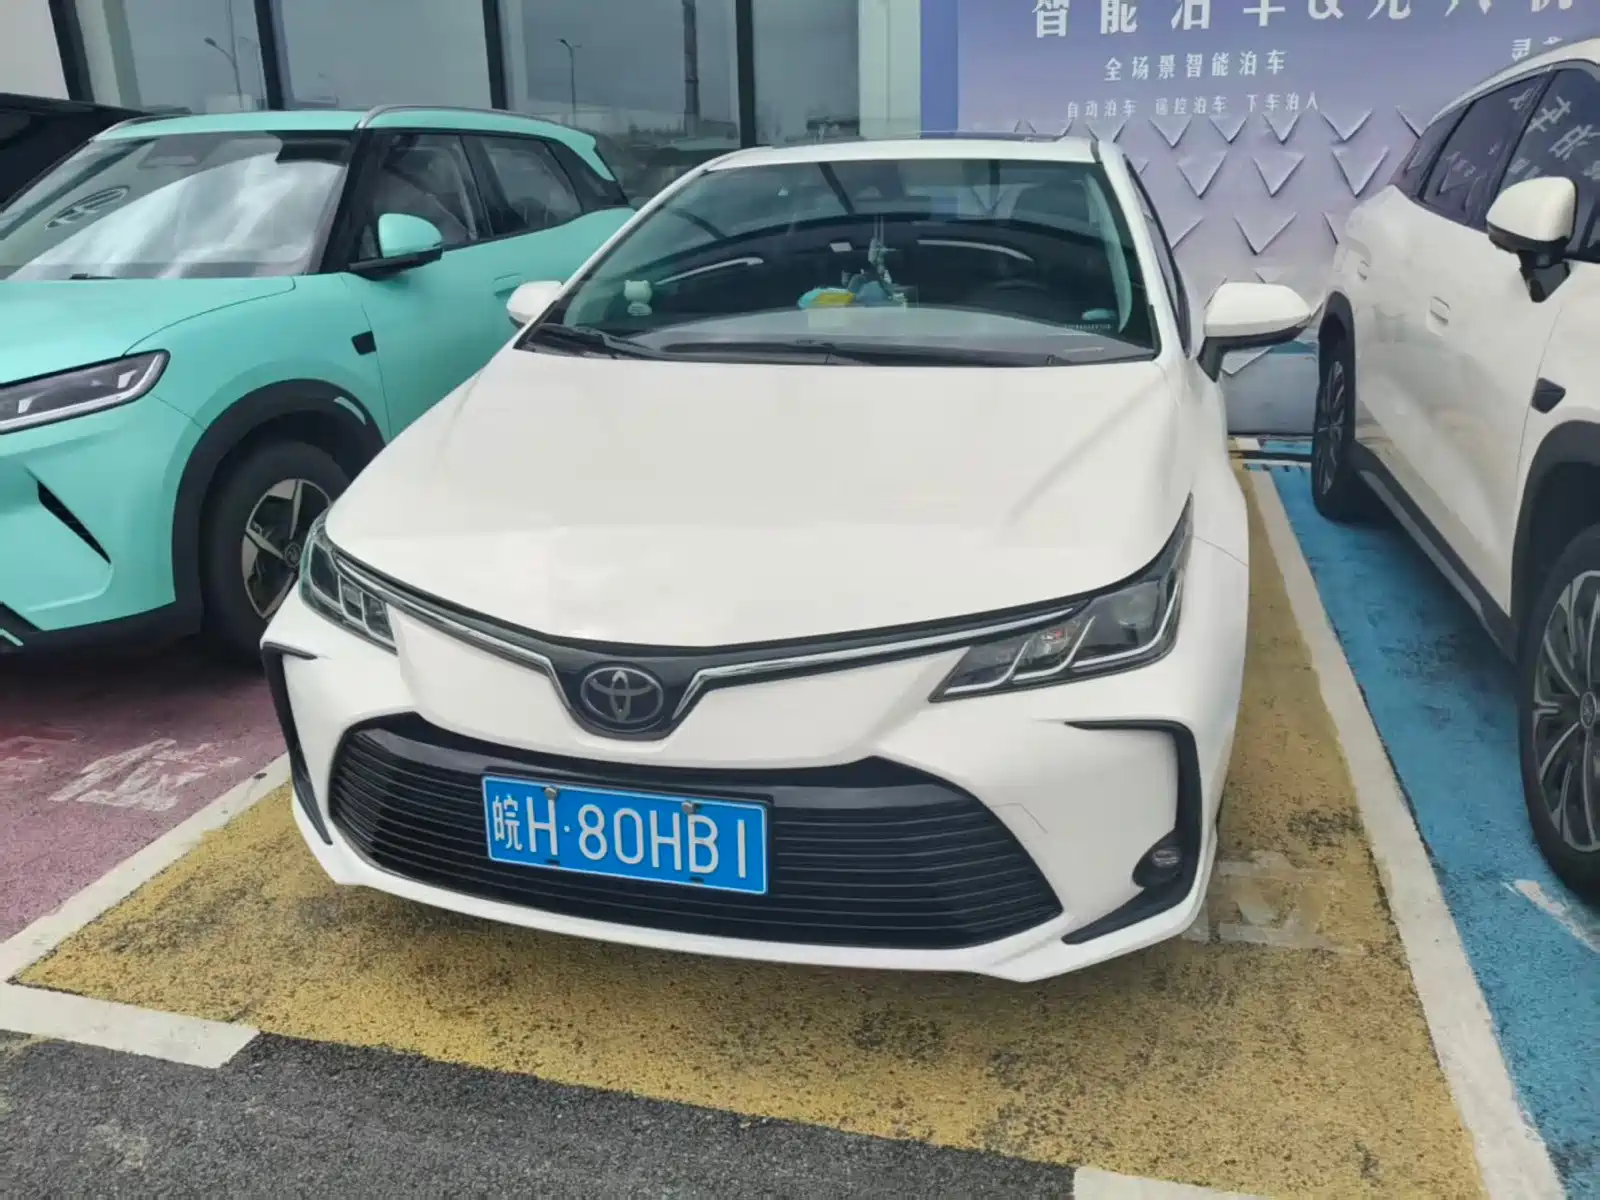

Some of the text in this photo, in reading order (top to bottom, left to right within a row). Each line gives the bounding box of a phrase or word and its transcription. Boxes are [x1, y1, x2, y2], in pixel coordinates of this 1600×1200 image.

[1104, 49, 1287, 82] 全场景智能泊车
[1067, 99, 1137, 120] 自动泊车
